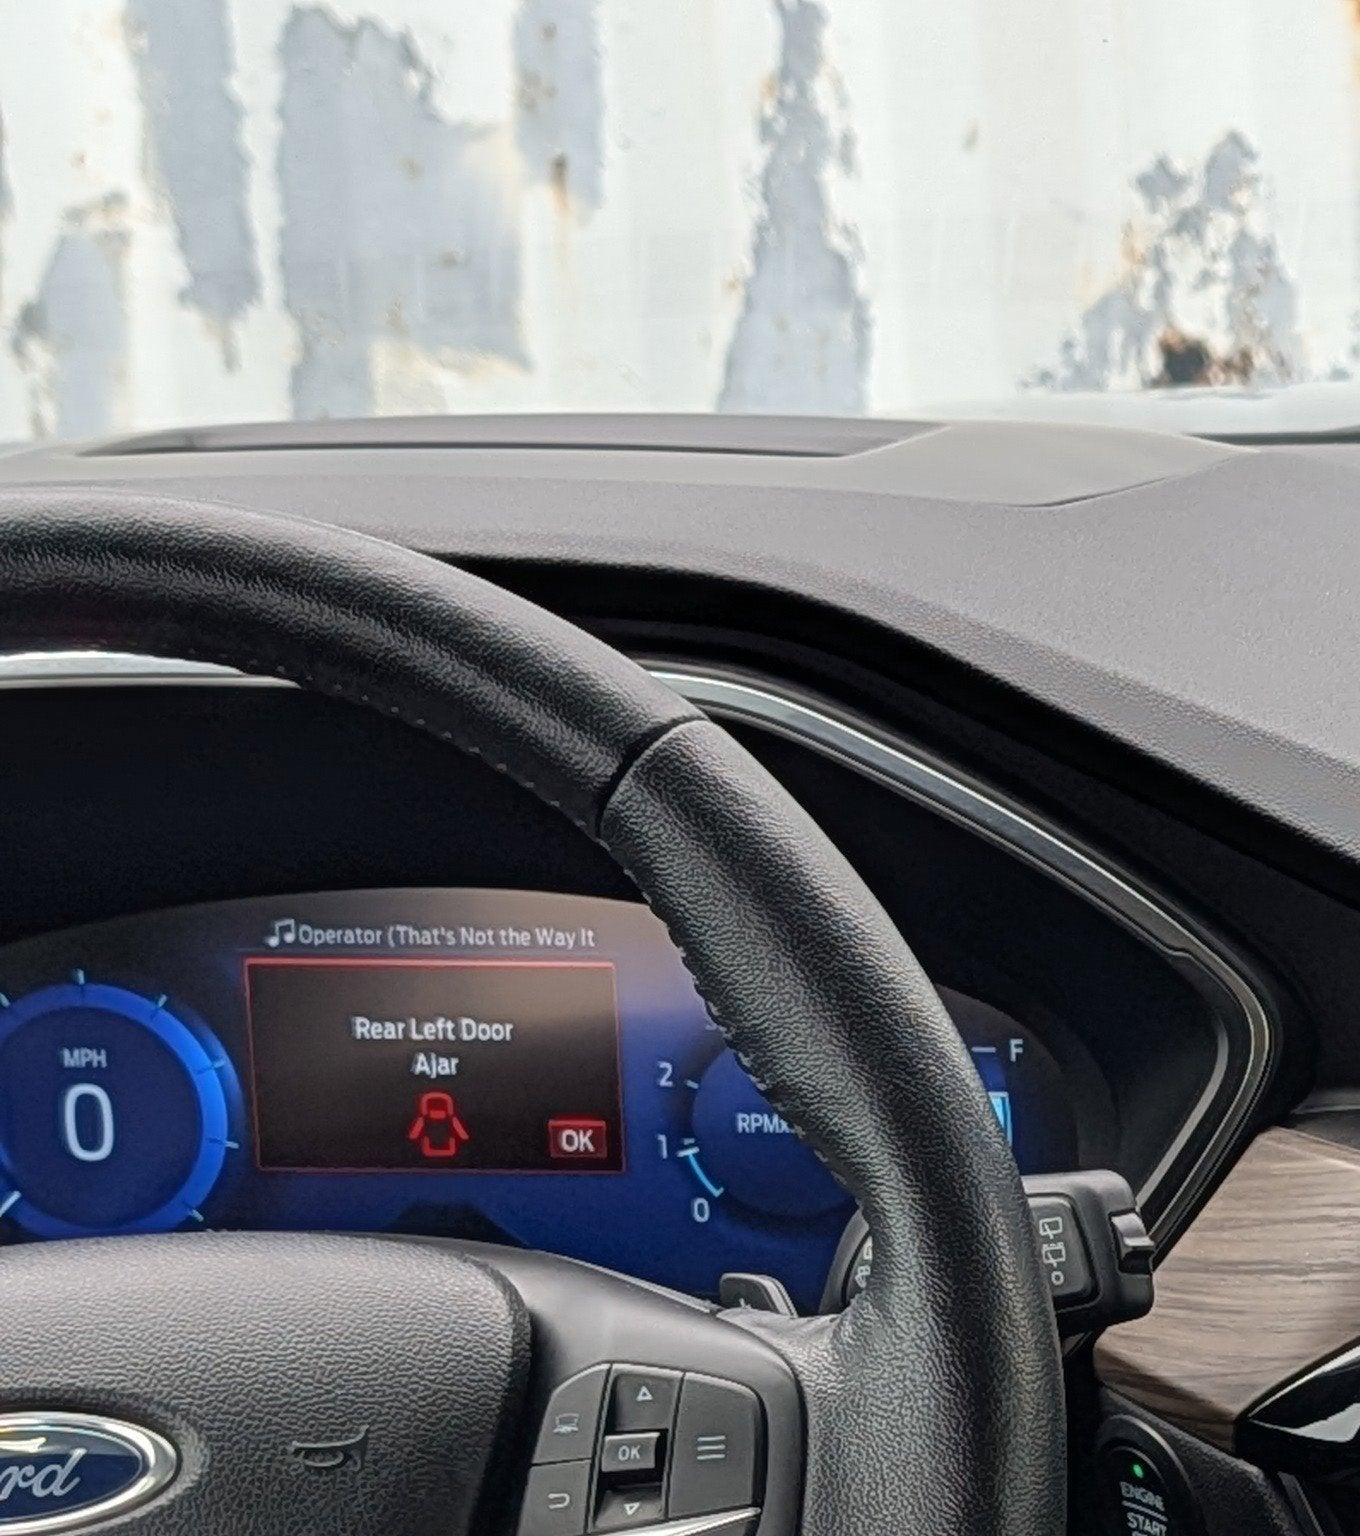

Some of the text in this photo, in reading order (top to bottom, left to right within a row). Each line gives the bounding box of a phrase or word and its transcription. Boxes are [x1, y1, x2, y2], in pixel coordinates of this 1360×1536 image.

[299, 925, 595, 950] Operator (That's Not the Way It
[352, 1017, 514, 1042] Rear Left Door
[62, 1047, 107, 1068] MPH
[1009, 1039, 1024, 1062] F
[412, 1052, 459, 1078] Ajar
[657, 1062, 674, 1088] 2
[64, 1083, 114, 1161] 0
[561, 1129, 594, 1152] OK
[658, 1134, 668, 1158] 1
[692, 1200, 710, 1222] 0
[618, 1445, 641, 1461] OK
